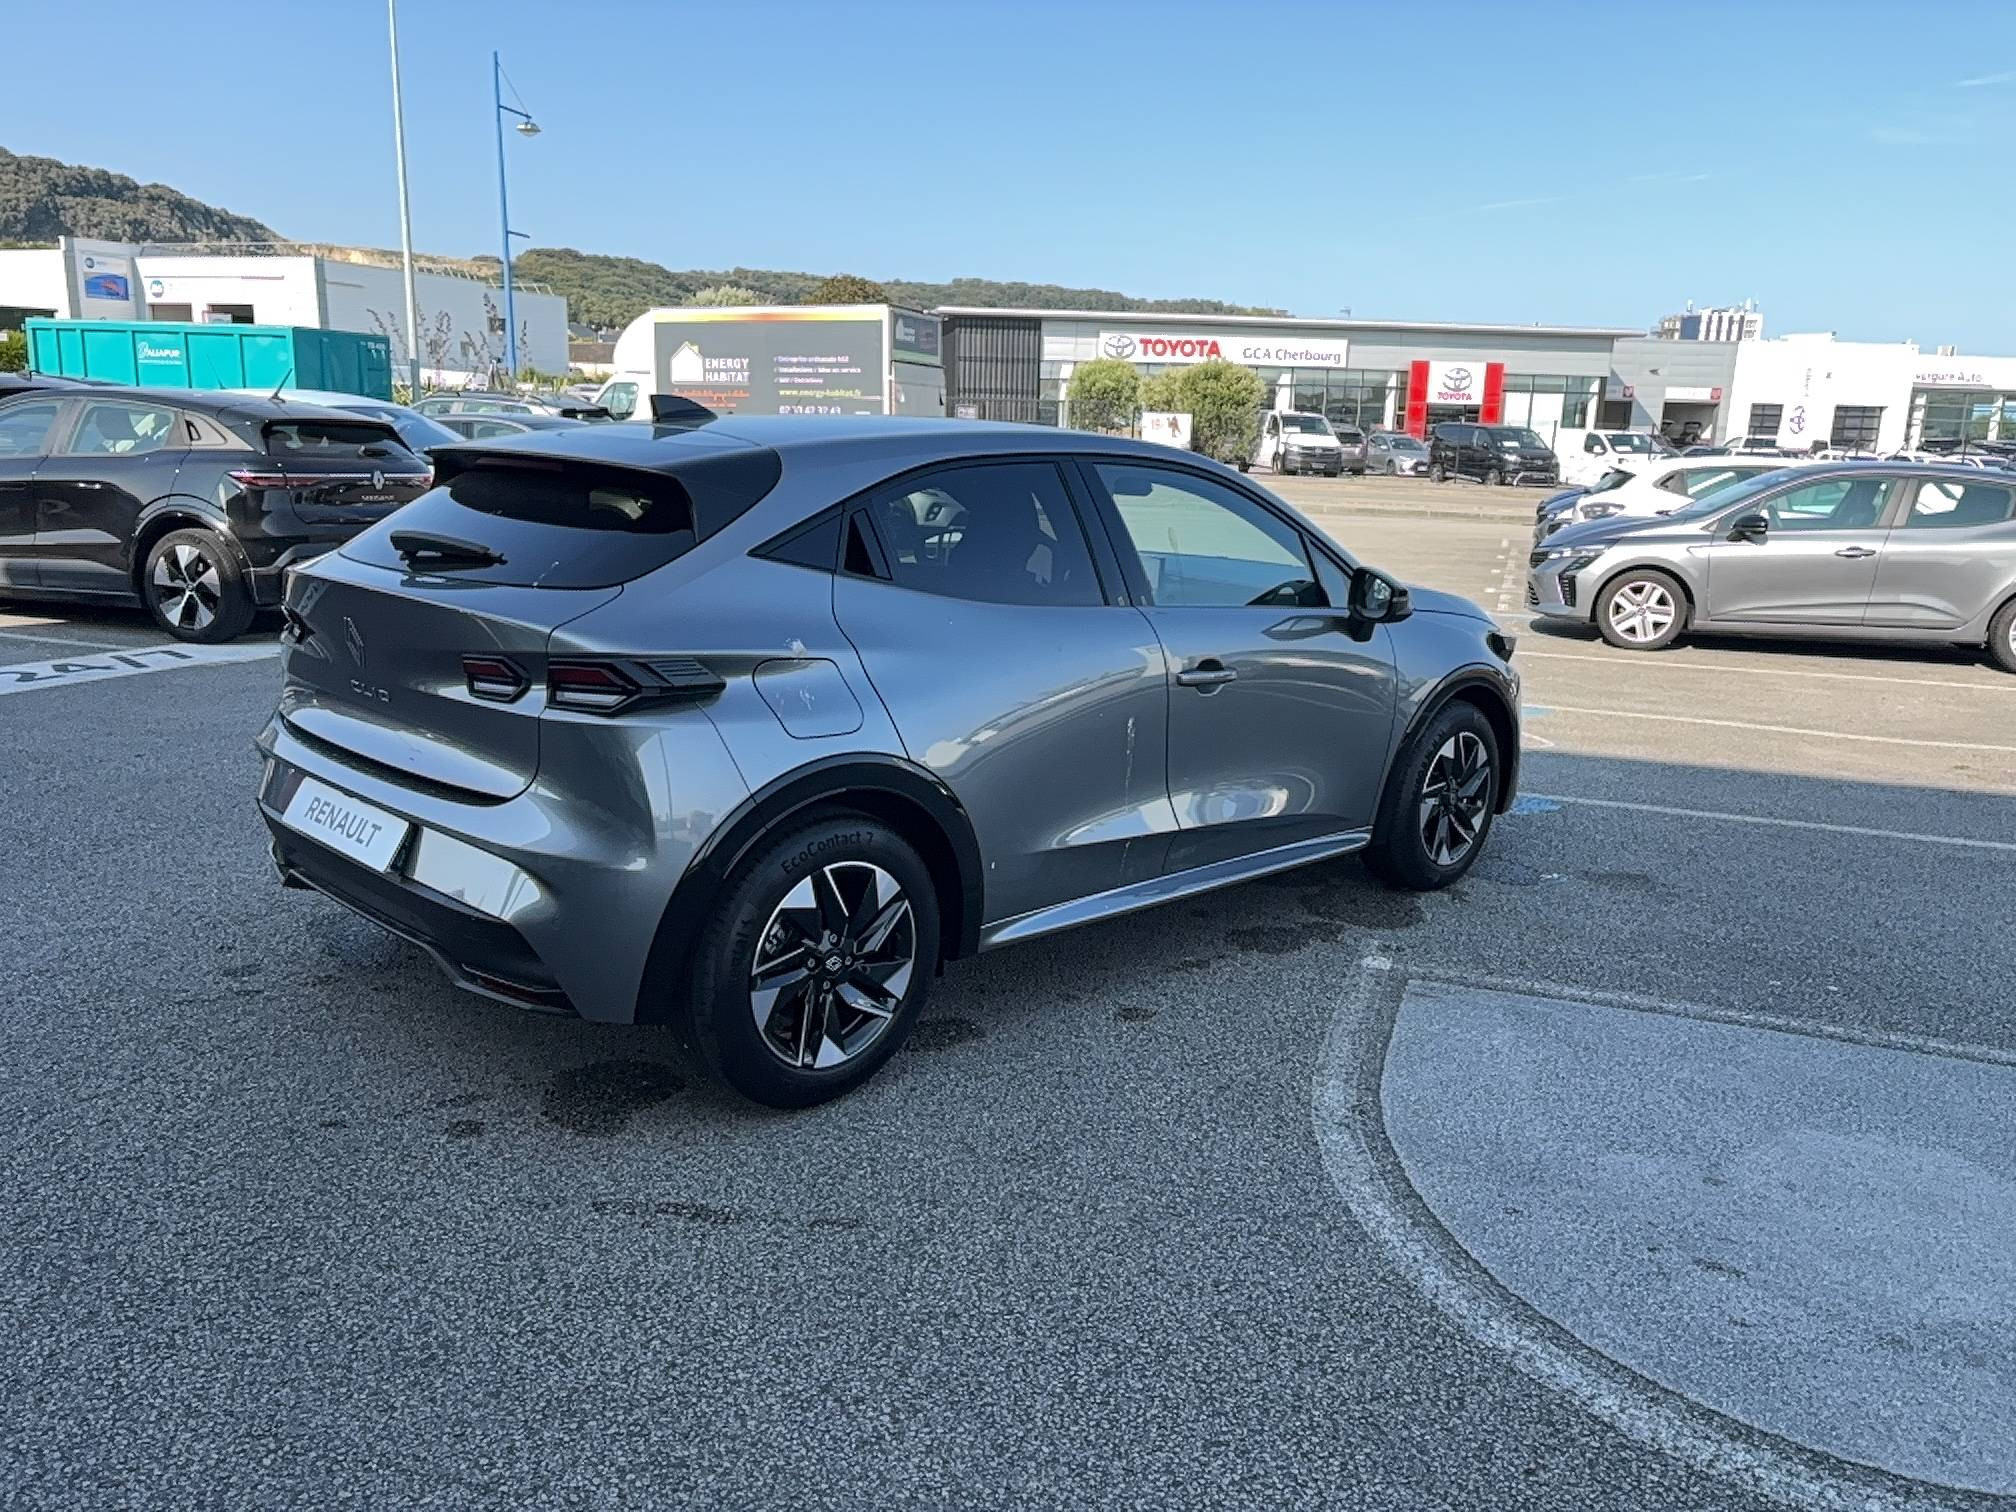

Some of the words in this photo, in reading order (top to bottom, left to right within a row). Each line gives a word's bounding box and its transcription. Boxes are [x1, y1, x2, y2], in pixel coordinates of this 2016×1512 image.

[1139, 338, 1221, 358] TOYOTA
[1275, 349, 1341, 365] Cherbourg
[705, 357, 749, 369] ENERGY
[705, 371, 750, 382] HABITAT
[1438, 391, 1472, 401] TOYOTA
[0, 650, 192, 682] 24/7
[304, 796, 383, 848] RENAULT
[780, 831, 863, 875] EcoContact
[866, 831, 875, 845] 7
